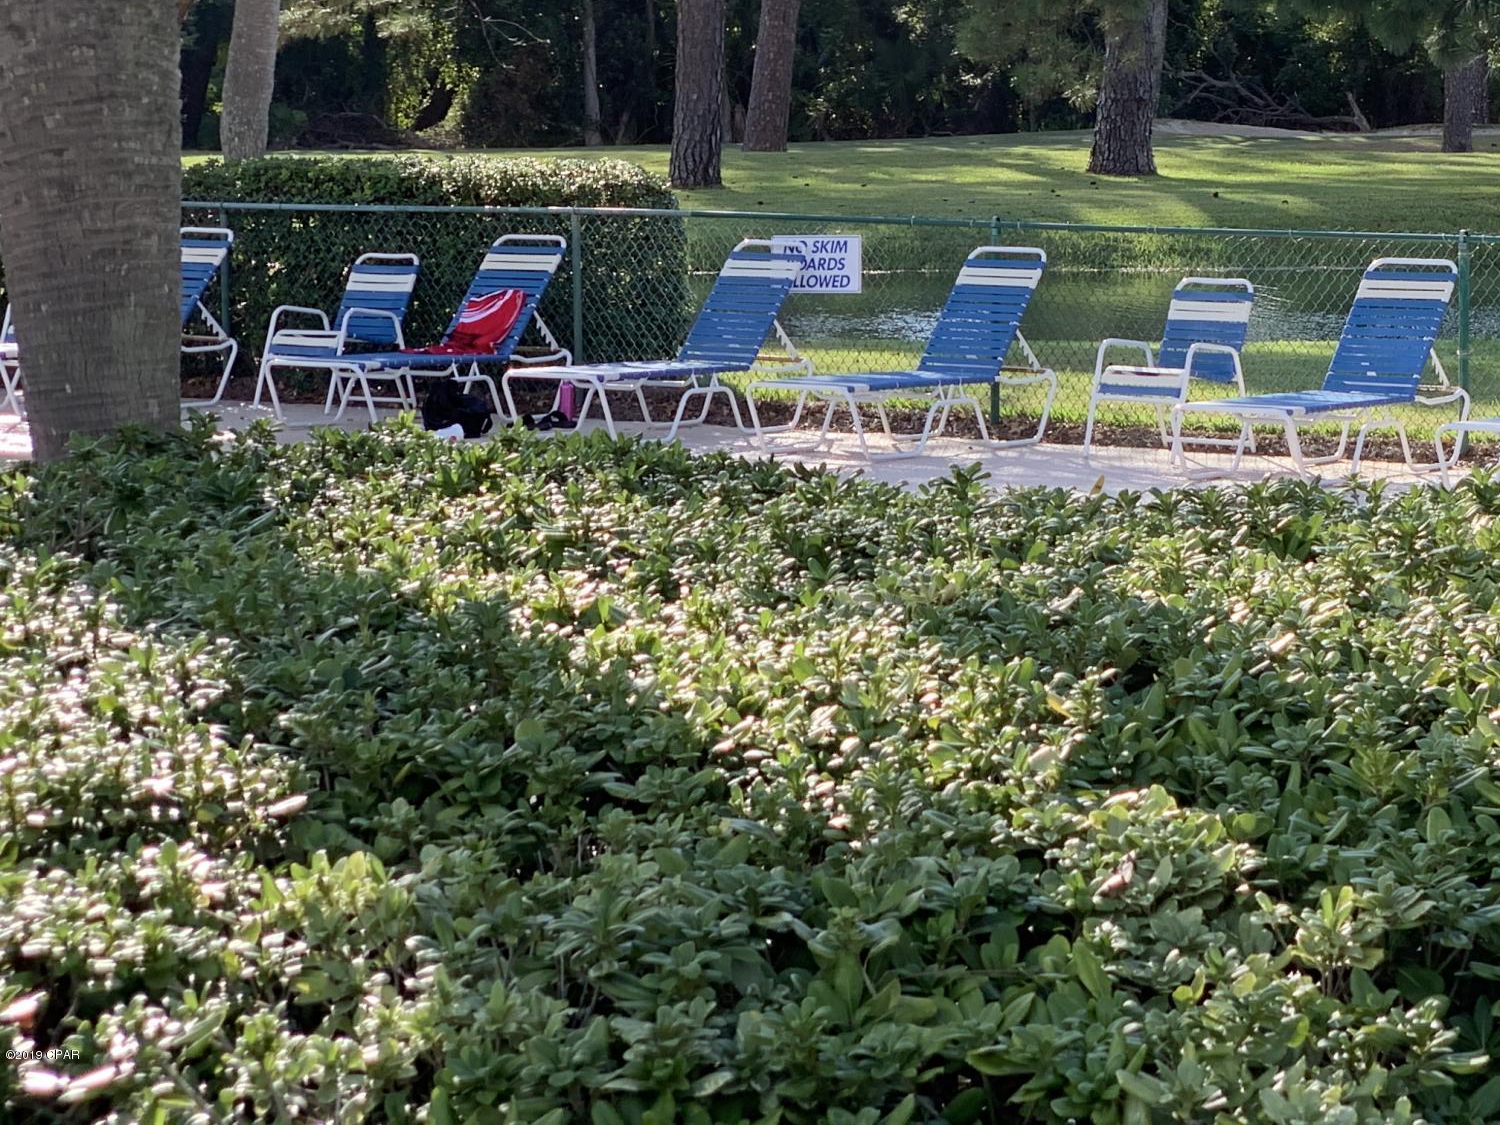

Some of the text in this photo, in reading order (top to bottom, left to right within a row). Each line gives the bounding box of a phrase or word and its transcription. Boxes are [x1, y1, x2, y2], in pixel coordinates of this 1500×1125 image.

[811, 240, 848, 254] SKIM
[788, 257, 846, 271] OARDS
[792, 274, 851, 289] LLOWED
